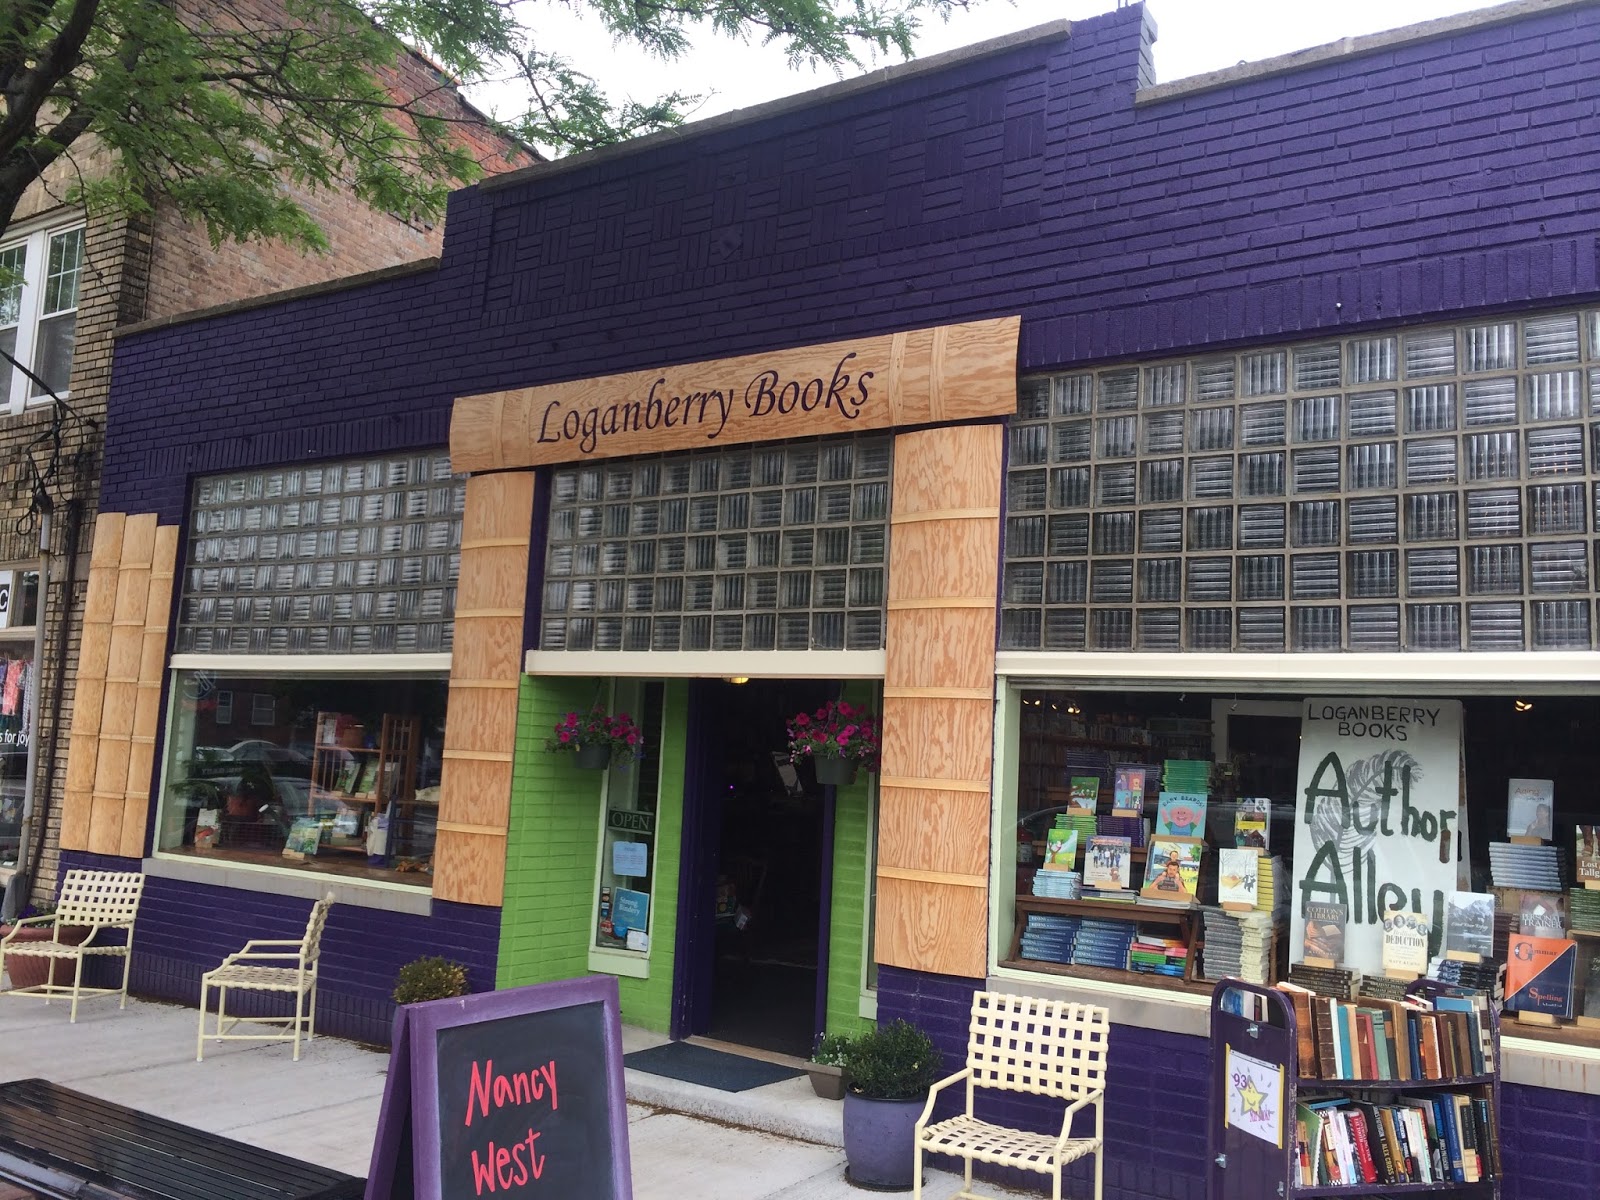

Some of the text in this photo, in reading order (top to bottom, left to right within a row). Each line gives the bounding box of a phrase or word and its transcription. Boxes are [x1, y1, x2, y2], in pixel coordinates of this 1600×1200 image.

[537, 352, 876, 454] Loganberry Books
[1307, 703, 1441, 727] LOGANBERRY
[4, 729, 16, 743] for
[16, 731, 30, 747] joy
[1337, 722, 1408, 741] BOOKS
[1304, 751, 1456, 863] Author
[612, 812, 650, 830] OPEN
[1581, 860, 1598, 868] Lost
[1299, 840, 1445, 963] Alley
[1306, 906, 1344, 916] COTTON'S
[1309, 912, 1339, 921] LIBRARY
[1521, 913, 1561, 923] PERSONAL
[1523, 919, 1562, 929] TRAINER
[1385, 935, 1425, 948] DEDUCTION
[1528, 986, 1563, 1006] Spelling
[464, 1059, 558, 1127] Nancy
[1381, 1143, 1390, 1157] ALEX
[471, 1128, 545, 1196] West
[1384, 1157, 1395, 1176] CROSS
